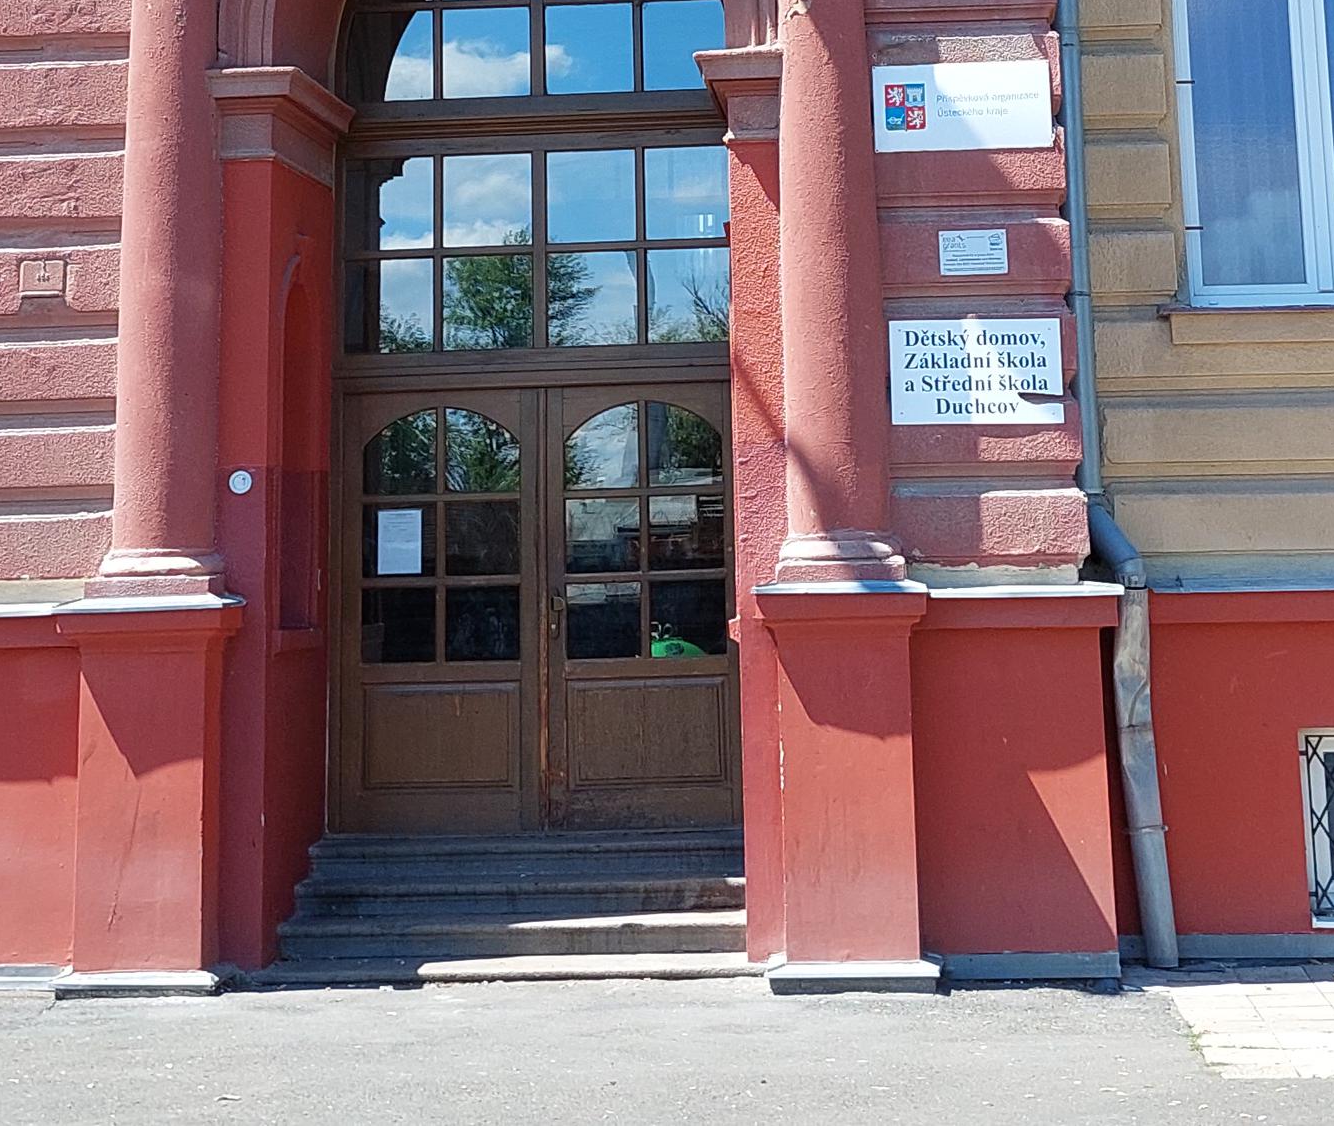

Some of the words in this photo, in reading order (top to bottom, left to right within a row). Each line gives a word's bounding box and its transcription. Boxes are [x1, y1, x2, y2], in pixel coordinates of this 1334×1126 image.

[991, 92, 1040, 103] organizace
[937, 106, 984, 117] Ústeckého
[986, 106, 1010, 117] kraje
[904, 329, 969, 351] Dětský
[976, 330, 1046, 348] domov,
[903, 351, 991, 370] Základní
[997, 351, 1048, 369] škola
[904, 379, 915, 392] a
[921, 374, 992, 392] Střední
[998, 374, 1049, 392] škola
[935, 398, 1020, 416] Duchcov
